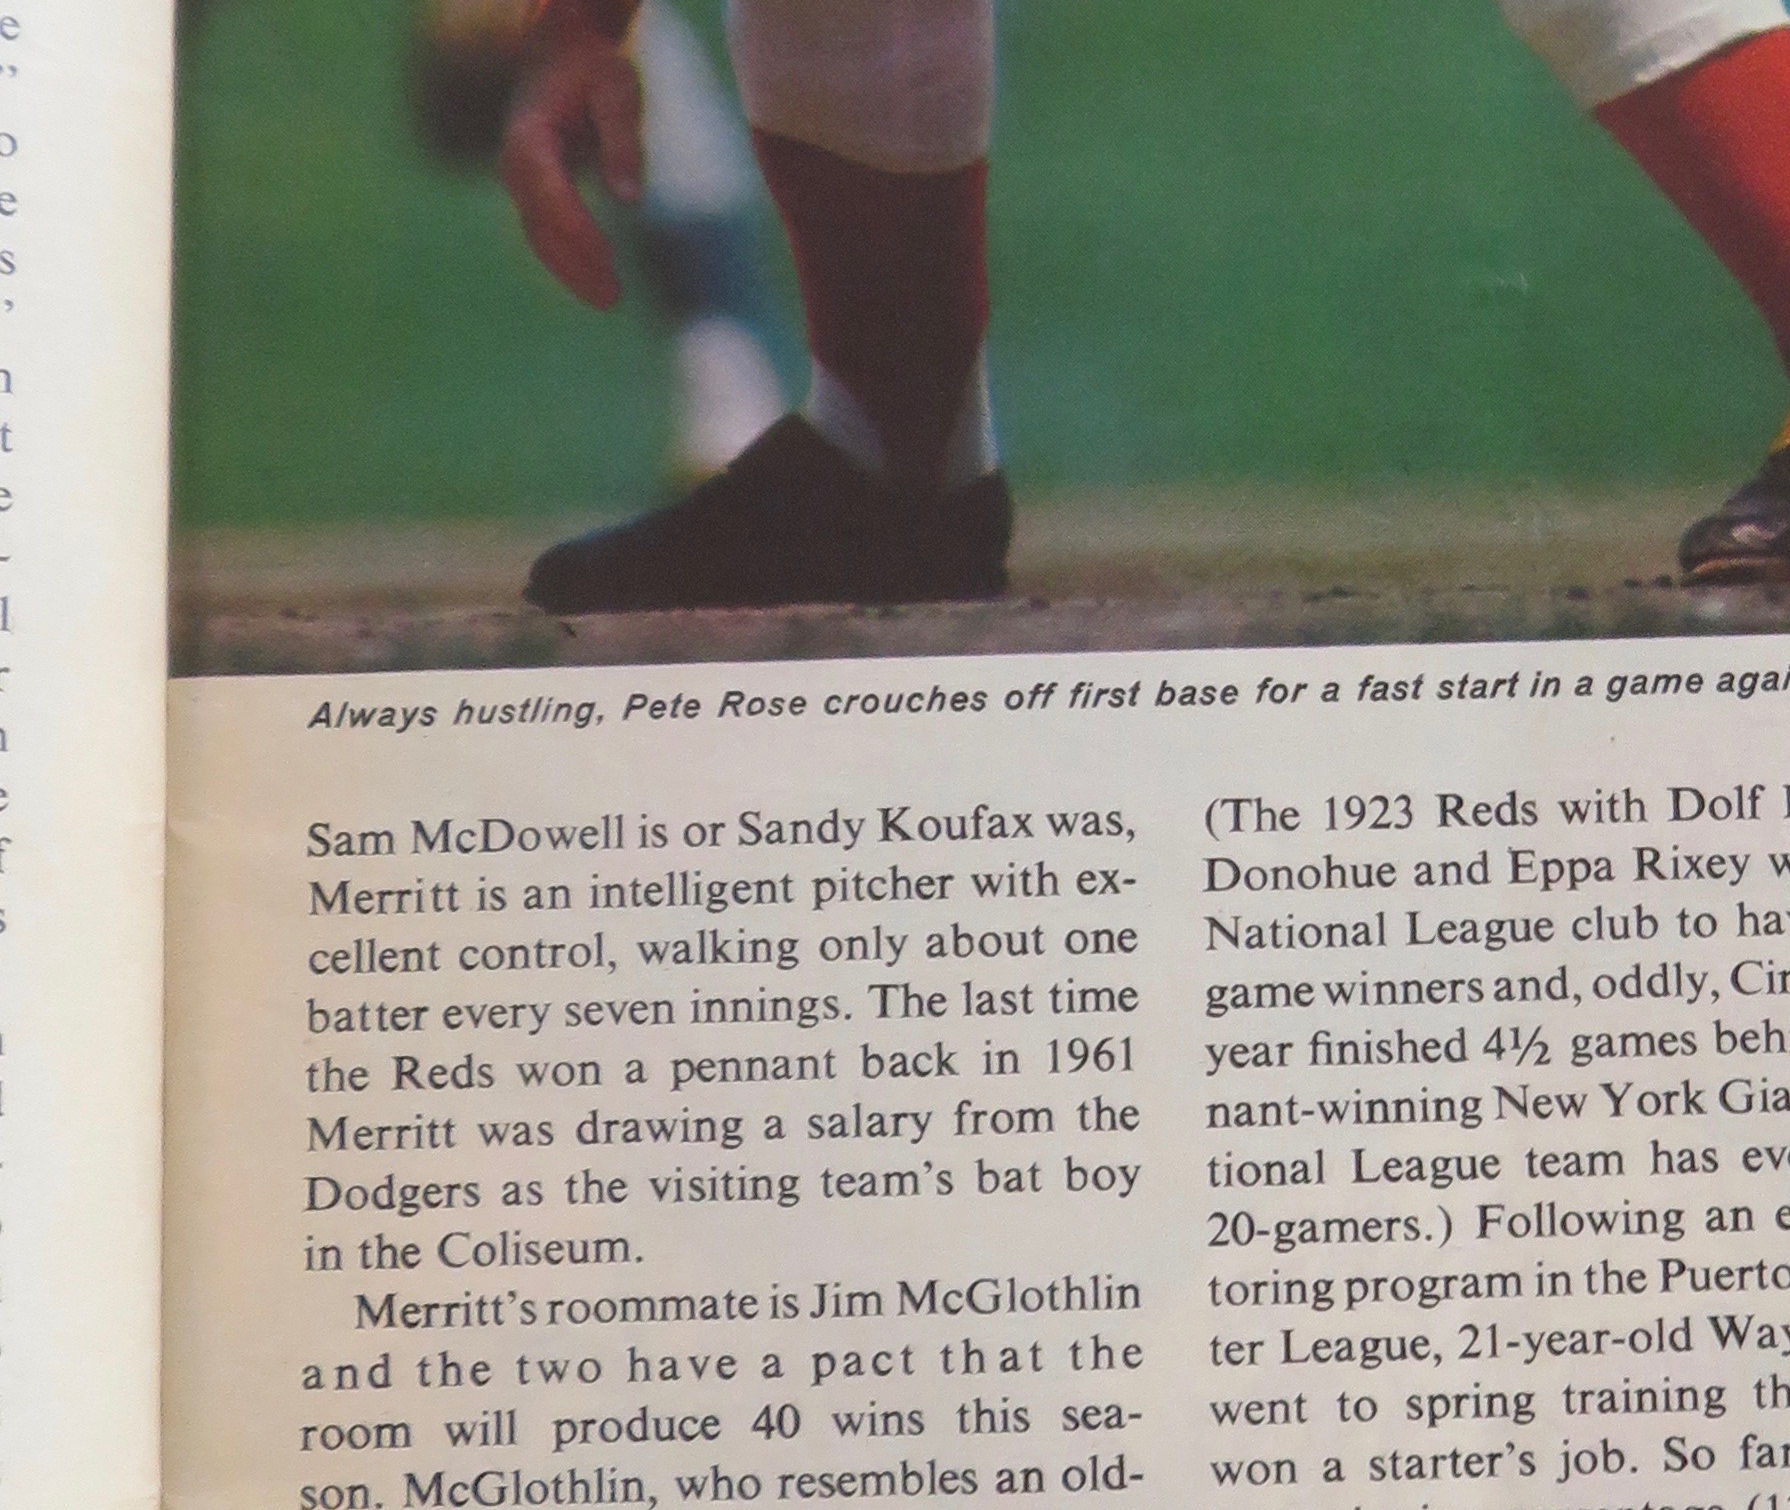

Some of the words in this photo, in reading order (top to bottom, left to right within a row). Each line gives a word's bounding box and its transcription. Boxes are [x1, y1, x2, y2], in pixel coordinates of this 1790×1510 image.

[306, 700, 439, 734] Always
[452, 696, 605, 730] hustling,
[622, 692, 702, 721] Pete
[717, 690, 808, 718] Rose
[823, 684, 989, 716] crouches
[1003, 681, 1059, 711] off
[1068, 680, 1142, 710] first
[1154, 679, 1240, 707] base
[1255, 676, 1309, 705] for
[1319, 681, 1341, 703] a
[1357, 673, 1425, 703] fast
[1435, 670, 1520, 701] start
[1528, 670, 1562, 699] in
[1573, 674, 1594, 697] a
[1605, 672, 1705, 704] game
[306, 822, 396, 858] Sam
[410, 813, 624, 855] McDowell
[638, 813, 669, 849] is
[682, 821, 727, 848] or
[737, 807, 866, 852] Sandy
[876, 803, 1035, 843] Koufax
[1045, 810, 1136, 844] was,
[1204, 796, 1301, 842] (The
[1325, 793, 1414, 832] 1923
[1434, 789, 1539, 828] Reds
[1557, 786, 1648, 825] with
[1666, 783, 1767, 822] Dolf
[1203, 910, 1387, 951] National
[1405, 910, 1555, 952] League
[1571, 903, 1660, 942] club
[1675, 907, 1719, 939] to
[305, 1056, 370, 1093] the
[391, 1052, 496, 1091] Reds
[515, 1060, 603, 1087] won
[624, 1058, 648, 1085] a
[670, 1048, 837, 1093] pennant
[859, 1040, 960, 1080] back
[982, 1039, 1021, 1076] in
[1048, 1035, 1133, 1074] 1961
[1205, 1086, 1484, 1130] nant-winning
[1492, 1083, 1588, 1121] New
[1598, 1078, 1708, 1118] York
[1207, 1204, 1453, 1254] 20-gamers.)
[1476, 1198, 1686, 1243] Following
[1705, 1205, 1755, 1234] an
[354, 1290, 538, 1330] Merritt's
[546, 1289, 760, 1326] roommate
[769, 1282, 800, 1320] is
[809, 1281, 884, 1320] Jim
[896, 1273, 1141, 1316] McGlothlin
[1209, 1335, 1265, 1367] ter
[1280, 1328, 1443, 1371] League,
[1457, 1315, 1694, 1366] 21-year-old
[403, 1466, 658, 1510] McGlothlin,
[674, 1464, 763, 1502] who
[777, 1458, 979, 1500] resembles
[995, 1466, 1046, 1495] an
[1061, 1452, 1144, 1493] old-
